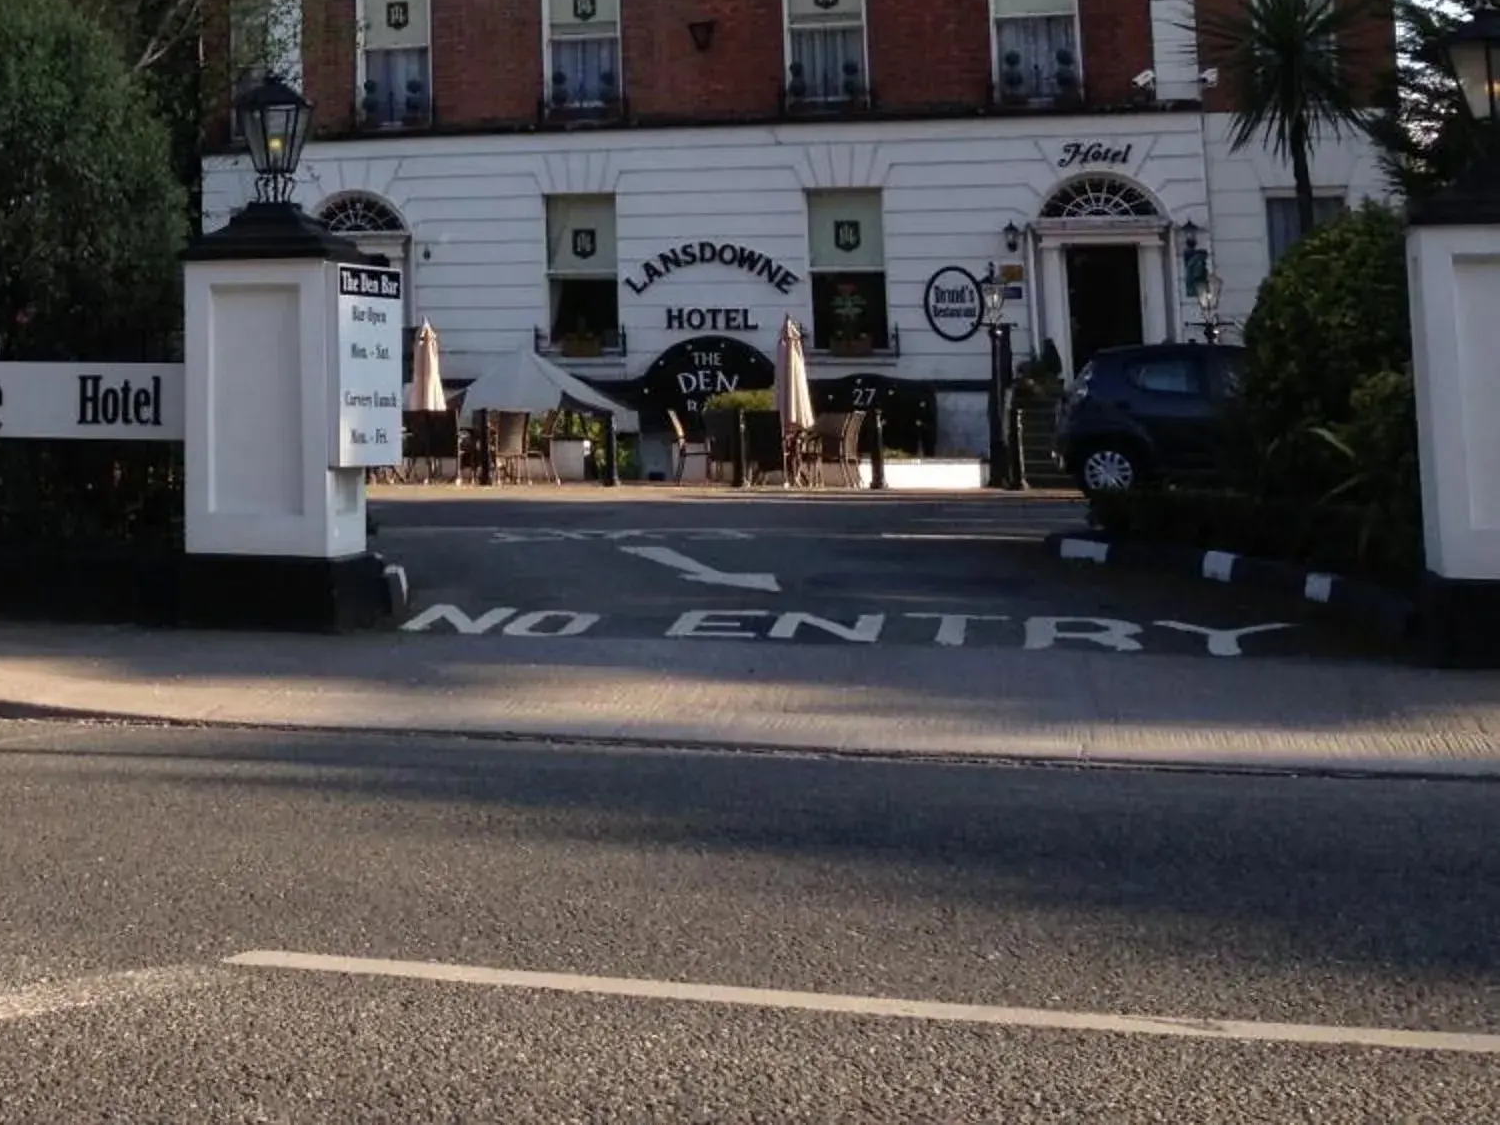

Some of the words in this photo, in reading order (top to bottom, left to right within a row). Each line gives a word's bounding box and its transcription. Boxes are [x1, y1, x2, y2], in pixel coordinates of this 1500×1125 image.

[1058, 143, 1132, 168] Hotel
[624, 241, 799, 295] LANSDOWNE
[341, 270, 359, 292] The
[360, 272, 379, 293] Den
[381, 274, 399, 295] Bar
[666, 308, 759, 331] HOTEL
[690, 352, 725, 366] THE
[677, 370, 739, 394] DEN
[76, 375, 162, 426] Hotel
[852, 388, 877, 406] 27
[400, 604, 600, 638] NO
[662, 608, 1298, 657] ENTRY
